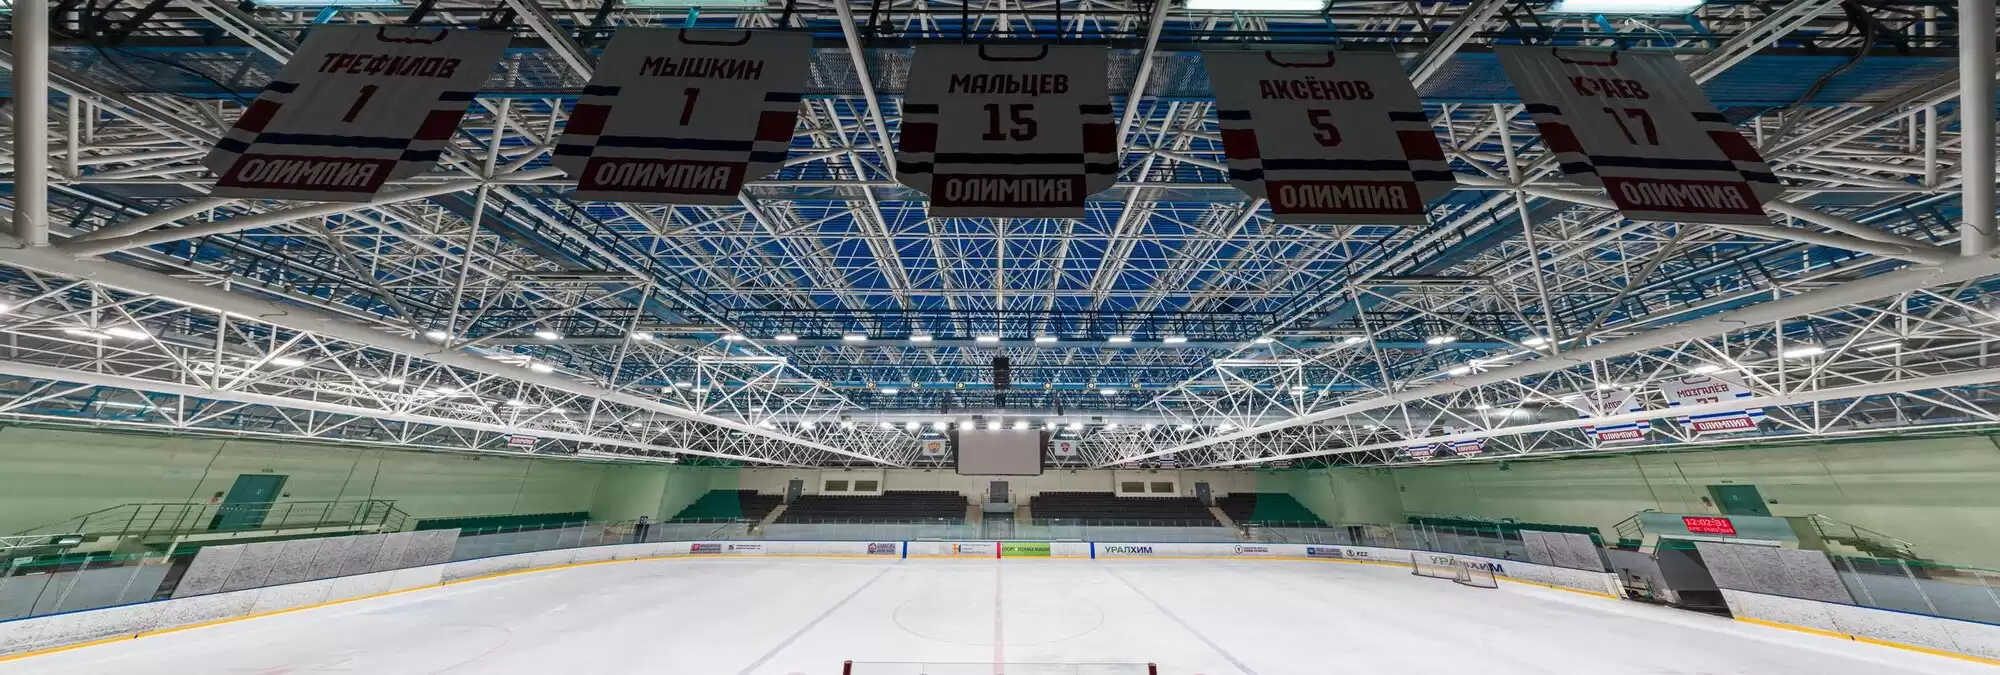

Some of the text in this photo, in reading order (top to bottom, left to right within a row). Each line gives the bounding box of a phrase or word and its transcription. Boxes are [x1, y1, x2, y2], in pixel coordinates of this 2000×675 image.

[318, 53, 461, 78] ТРЕФИЛОВ
[640, 56, 764, 80] МЫШКИН
[948, 74, 1068, 96] МАЛЬЦЕВ
[1259, 76, 1375, 100] АКСЁНОВ
[342, 84, 379, 123] 1
[679, 87, 700, 126] 1
[982, 103, 1037, 141] 15
[1307, 108, 1342, 146] 5
[1603, 107, 1660, 145] 17
[237, 158, 379, 187] ОЛИМПИЯ
[595, 162, 731, 190] ОЛИМПИЯ
[945, 178, 1073, 201] ОЛИМПИЯ
[1279, 184, 1408, 209] ОЛИМПИЯ
[1620, 181, 1749, 209] ОЛИМПИЯ
[1677, 383, 1729, 398] МОЗГАЛЁВ
[1602, 431, 1639, 440] ОЛИМПИЯ
[1700, 419, 1748, 430] ОЛИМПИЯ
[1105, 546, 1153, 554] УРАЛХИМ
[1430, 555, 1504, 572] УРАХИМ
